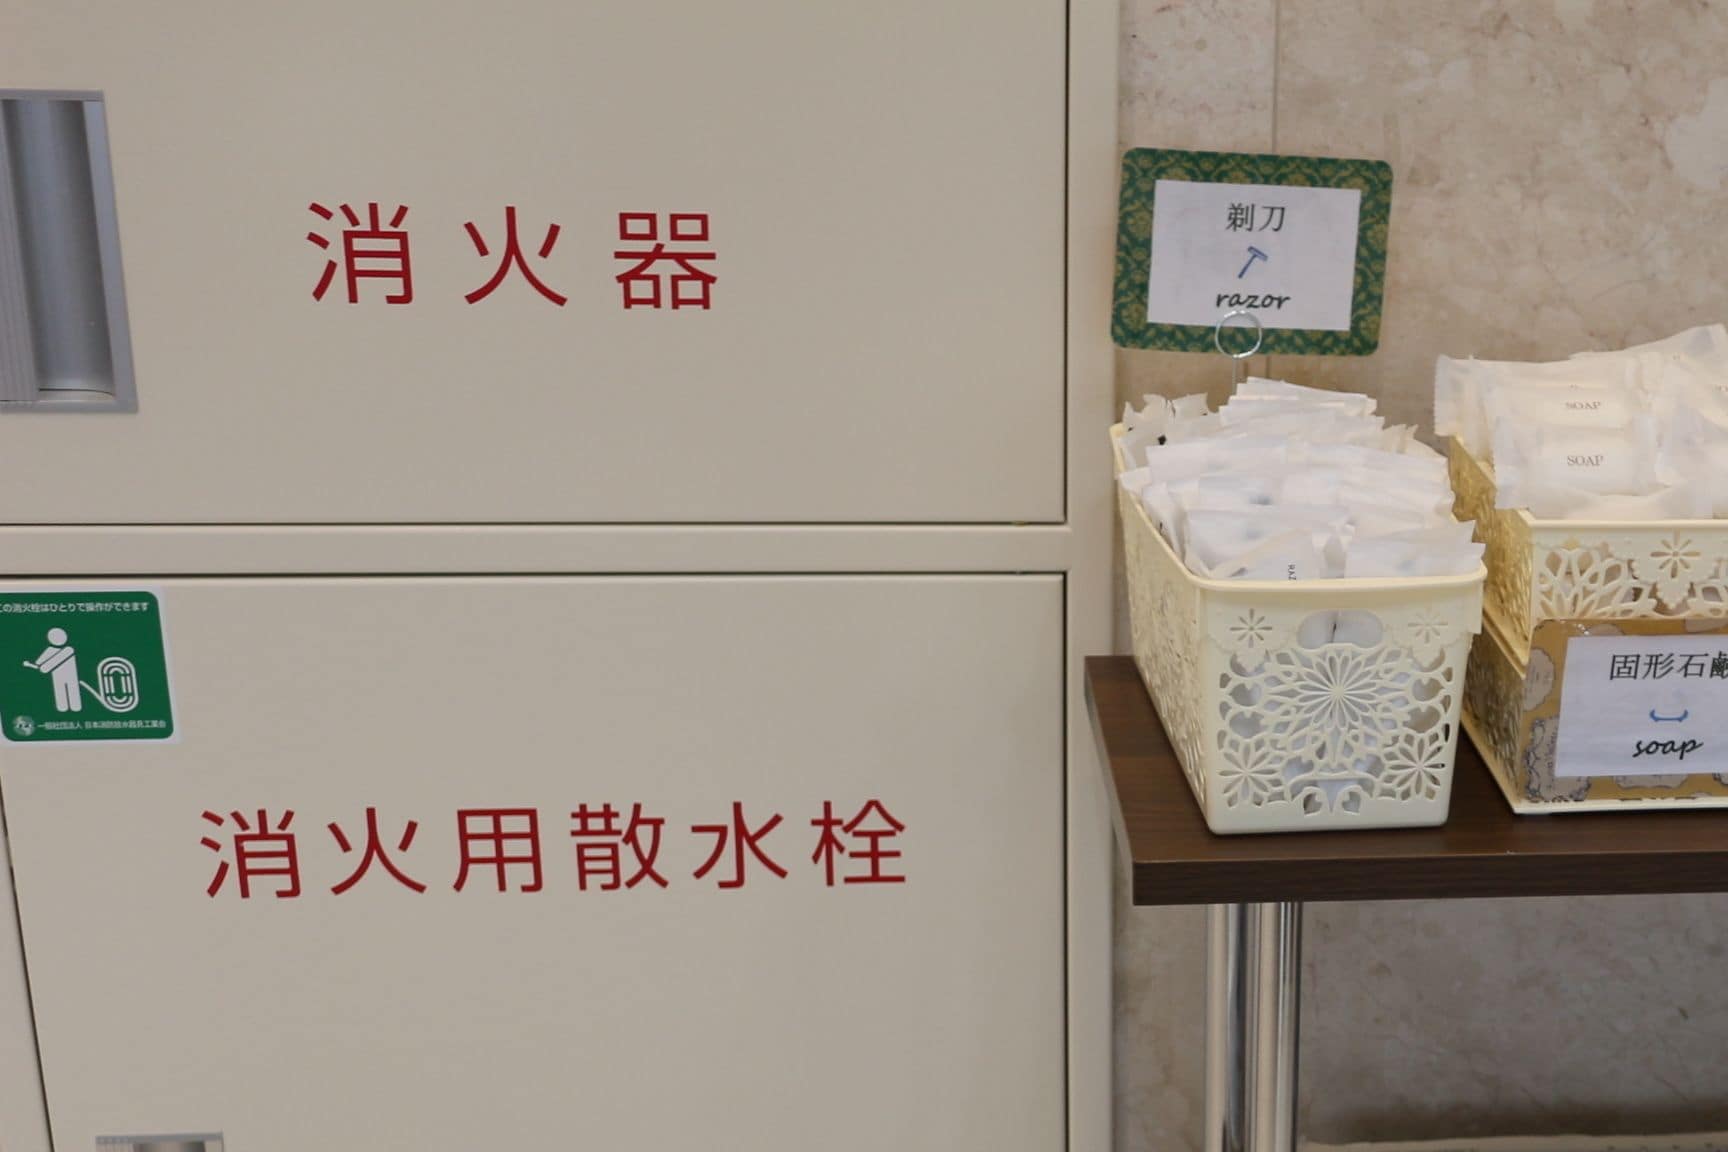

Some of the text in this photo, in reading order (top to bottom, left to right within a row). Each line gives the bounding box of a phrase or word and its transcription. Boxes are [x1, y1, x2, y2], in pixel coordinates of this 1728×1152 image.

[1226, 203, 1286, 233] 剃刀
[308, 203, 717, 310] 消火器
[1215, 293, 1291, 310] razor
[1565, 401, 1601, 410] SOAP
[1567, 455, 1604, 467] SOAP
[1632, 739, 1704, 760] soap
[200, 799, 906, 899] 消火用散水栓
